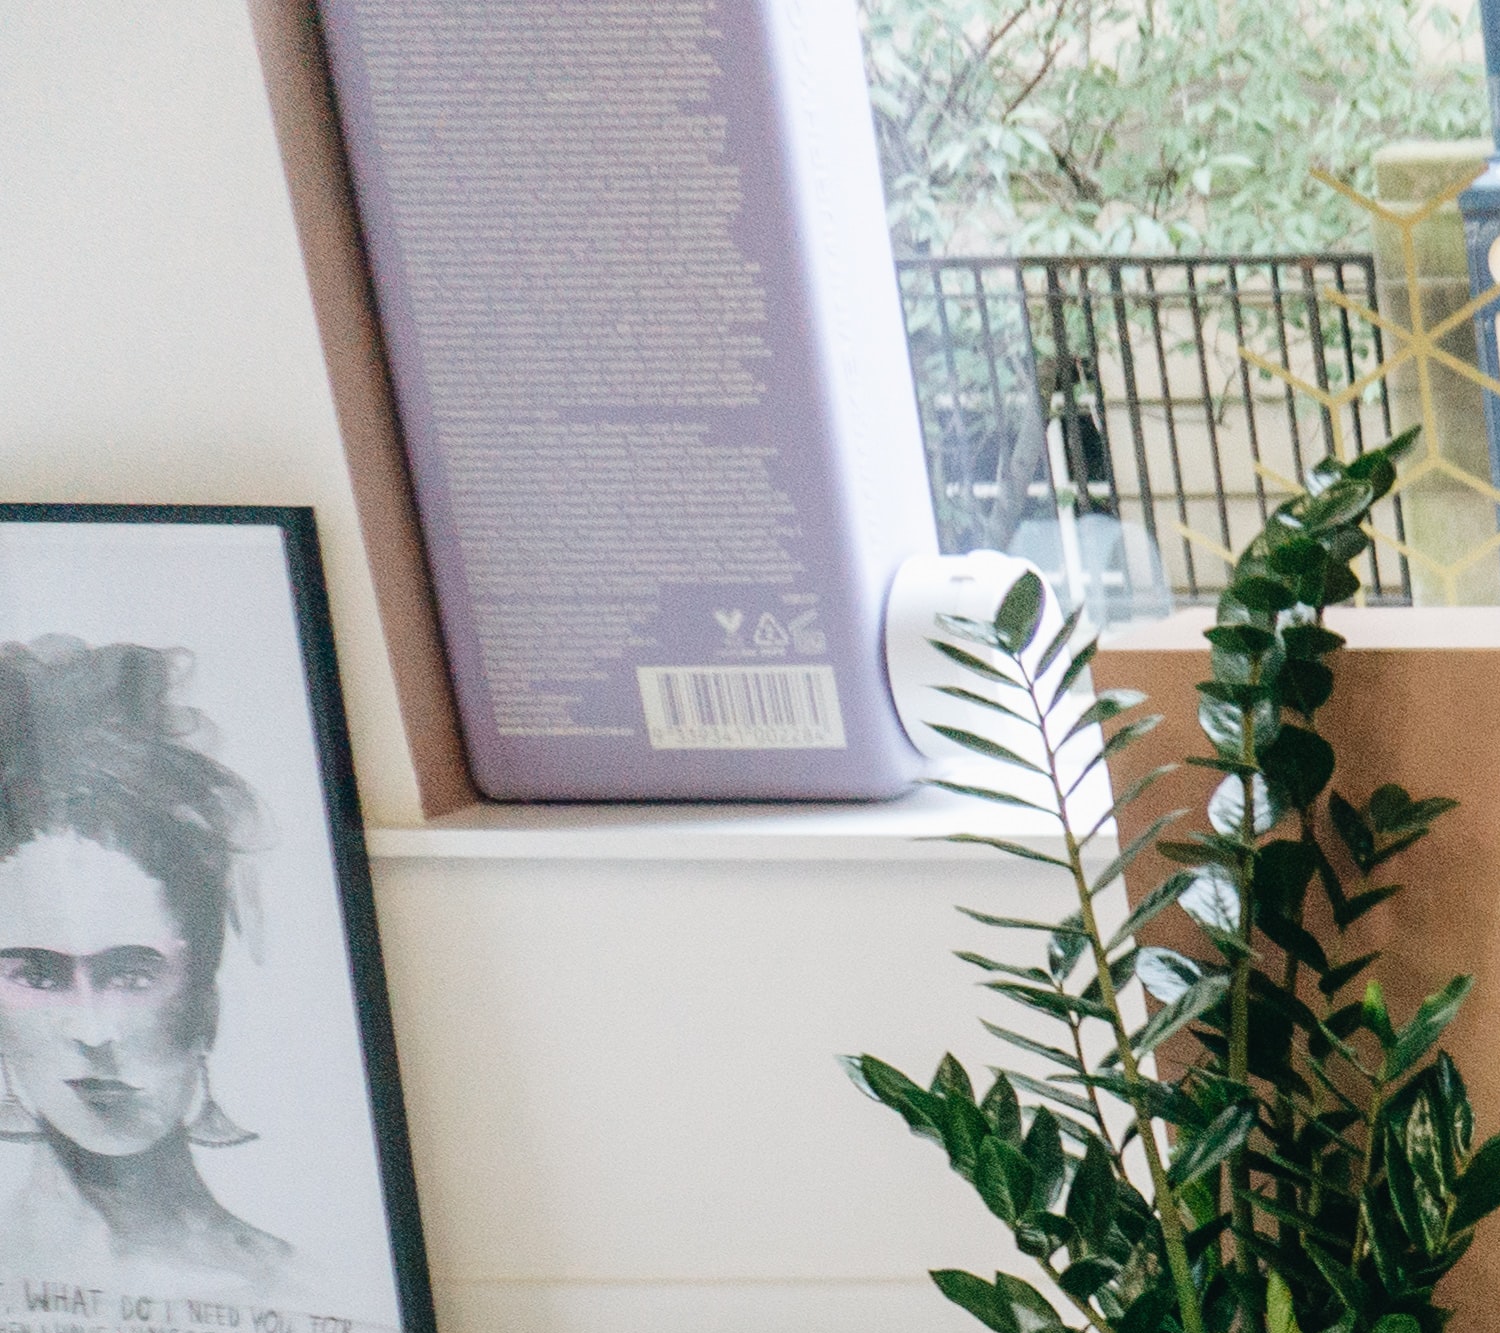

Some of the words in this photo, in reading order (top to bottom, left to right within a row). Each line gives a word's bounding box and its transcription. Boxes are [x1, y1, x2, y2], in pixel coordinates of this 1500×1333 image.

[24, 1279, 104, 1318] WHAT
[121, 1294, 152, 1322] DO
[166, 1300, 173, 1323] I
[188, 1299, 241, 1327] NEED
